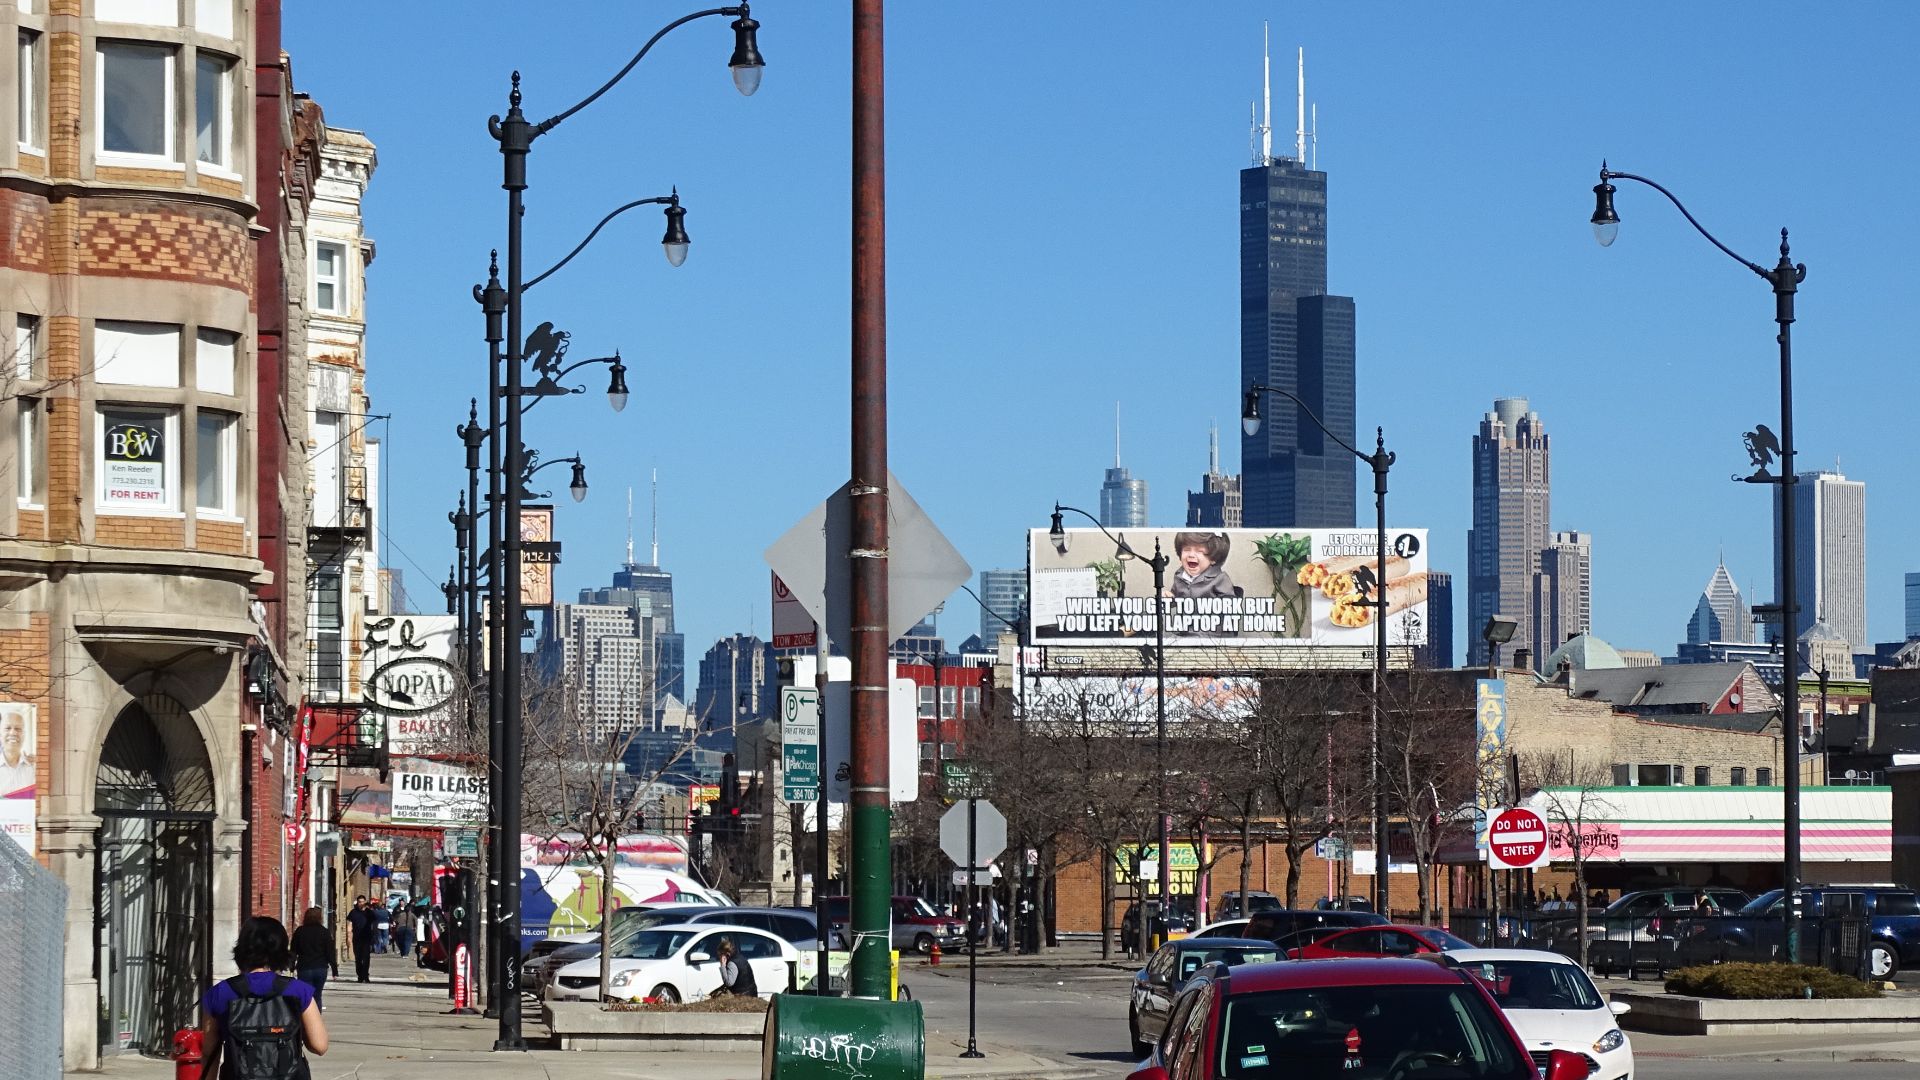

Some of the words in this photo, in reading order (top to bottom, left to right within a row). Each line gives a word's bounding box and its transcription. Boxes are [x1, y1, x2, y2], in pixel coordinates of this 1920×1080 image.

[110, 428, 158, 459] B&W
[128, 465, 153, 473] Reeder
[111, 489, 131, 498] FOR
[133, 491, 160, 499] RENT
[1329, 533, 1345, 546] LET
[1346, 533, 1360, 546] US
[1361, 533, 1388, 546] MAE
[1322, 545, 1342, 557] YOU
[1343, 545, 1397, 557] BREAKFST
[1065, 597, 1111, 615] WHEN
[1112, 597, 1143, 615] YOU
[1145, 597, 1173, 615] GT
[1174, 597, 1195, 615] TO
[1196, 597, 1244, 615] WORK
[1245, 597, 1275, 615] BUT
[1056, 615, 1088, 632] YOU
[1089, 615, 1121, 632] LEFT
[1164, 615, 1222, 632] LAPTOP
[1222, 615, 1242, 632] AT
[1243, 615, 1286, 632] HOME
[775, 636, 791, 647] TOW
[793, 633, 813, 646] ZONE
[384, 674, 453, 695] NOPAL
[785, 727, 793, 736] PAY
[793, 727, 798, 736] AT
[798, 727, 807, 736] PAY
[807, 727, 816, 736] BOX
[402, 774, 434, 791] FOR
[793, 789, 804, 800] 364
[804, 789, 815, 800] 706
[1496, 820, 1511, 831] DO
[1517, 818, 1538, 830] NOT
[1502, 845, 1536, 857] ENTER
